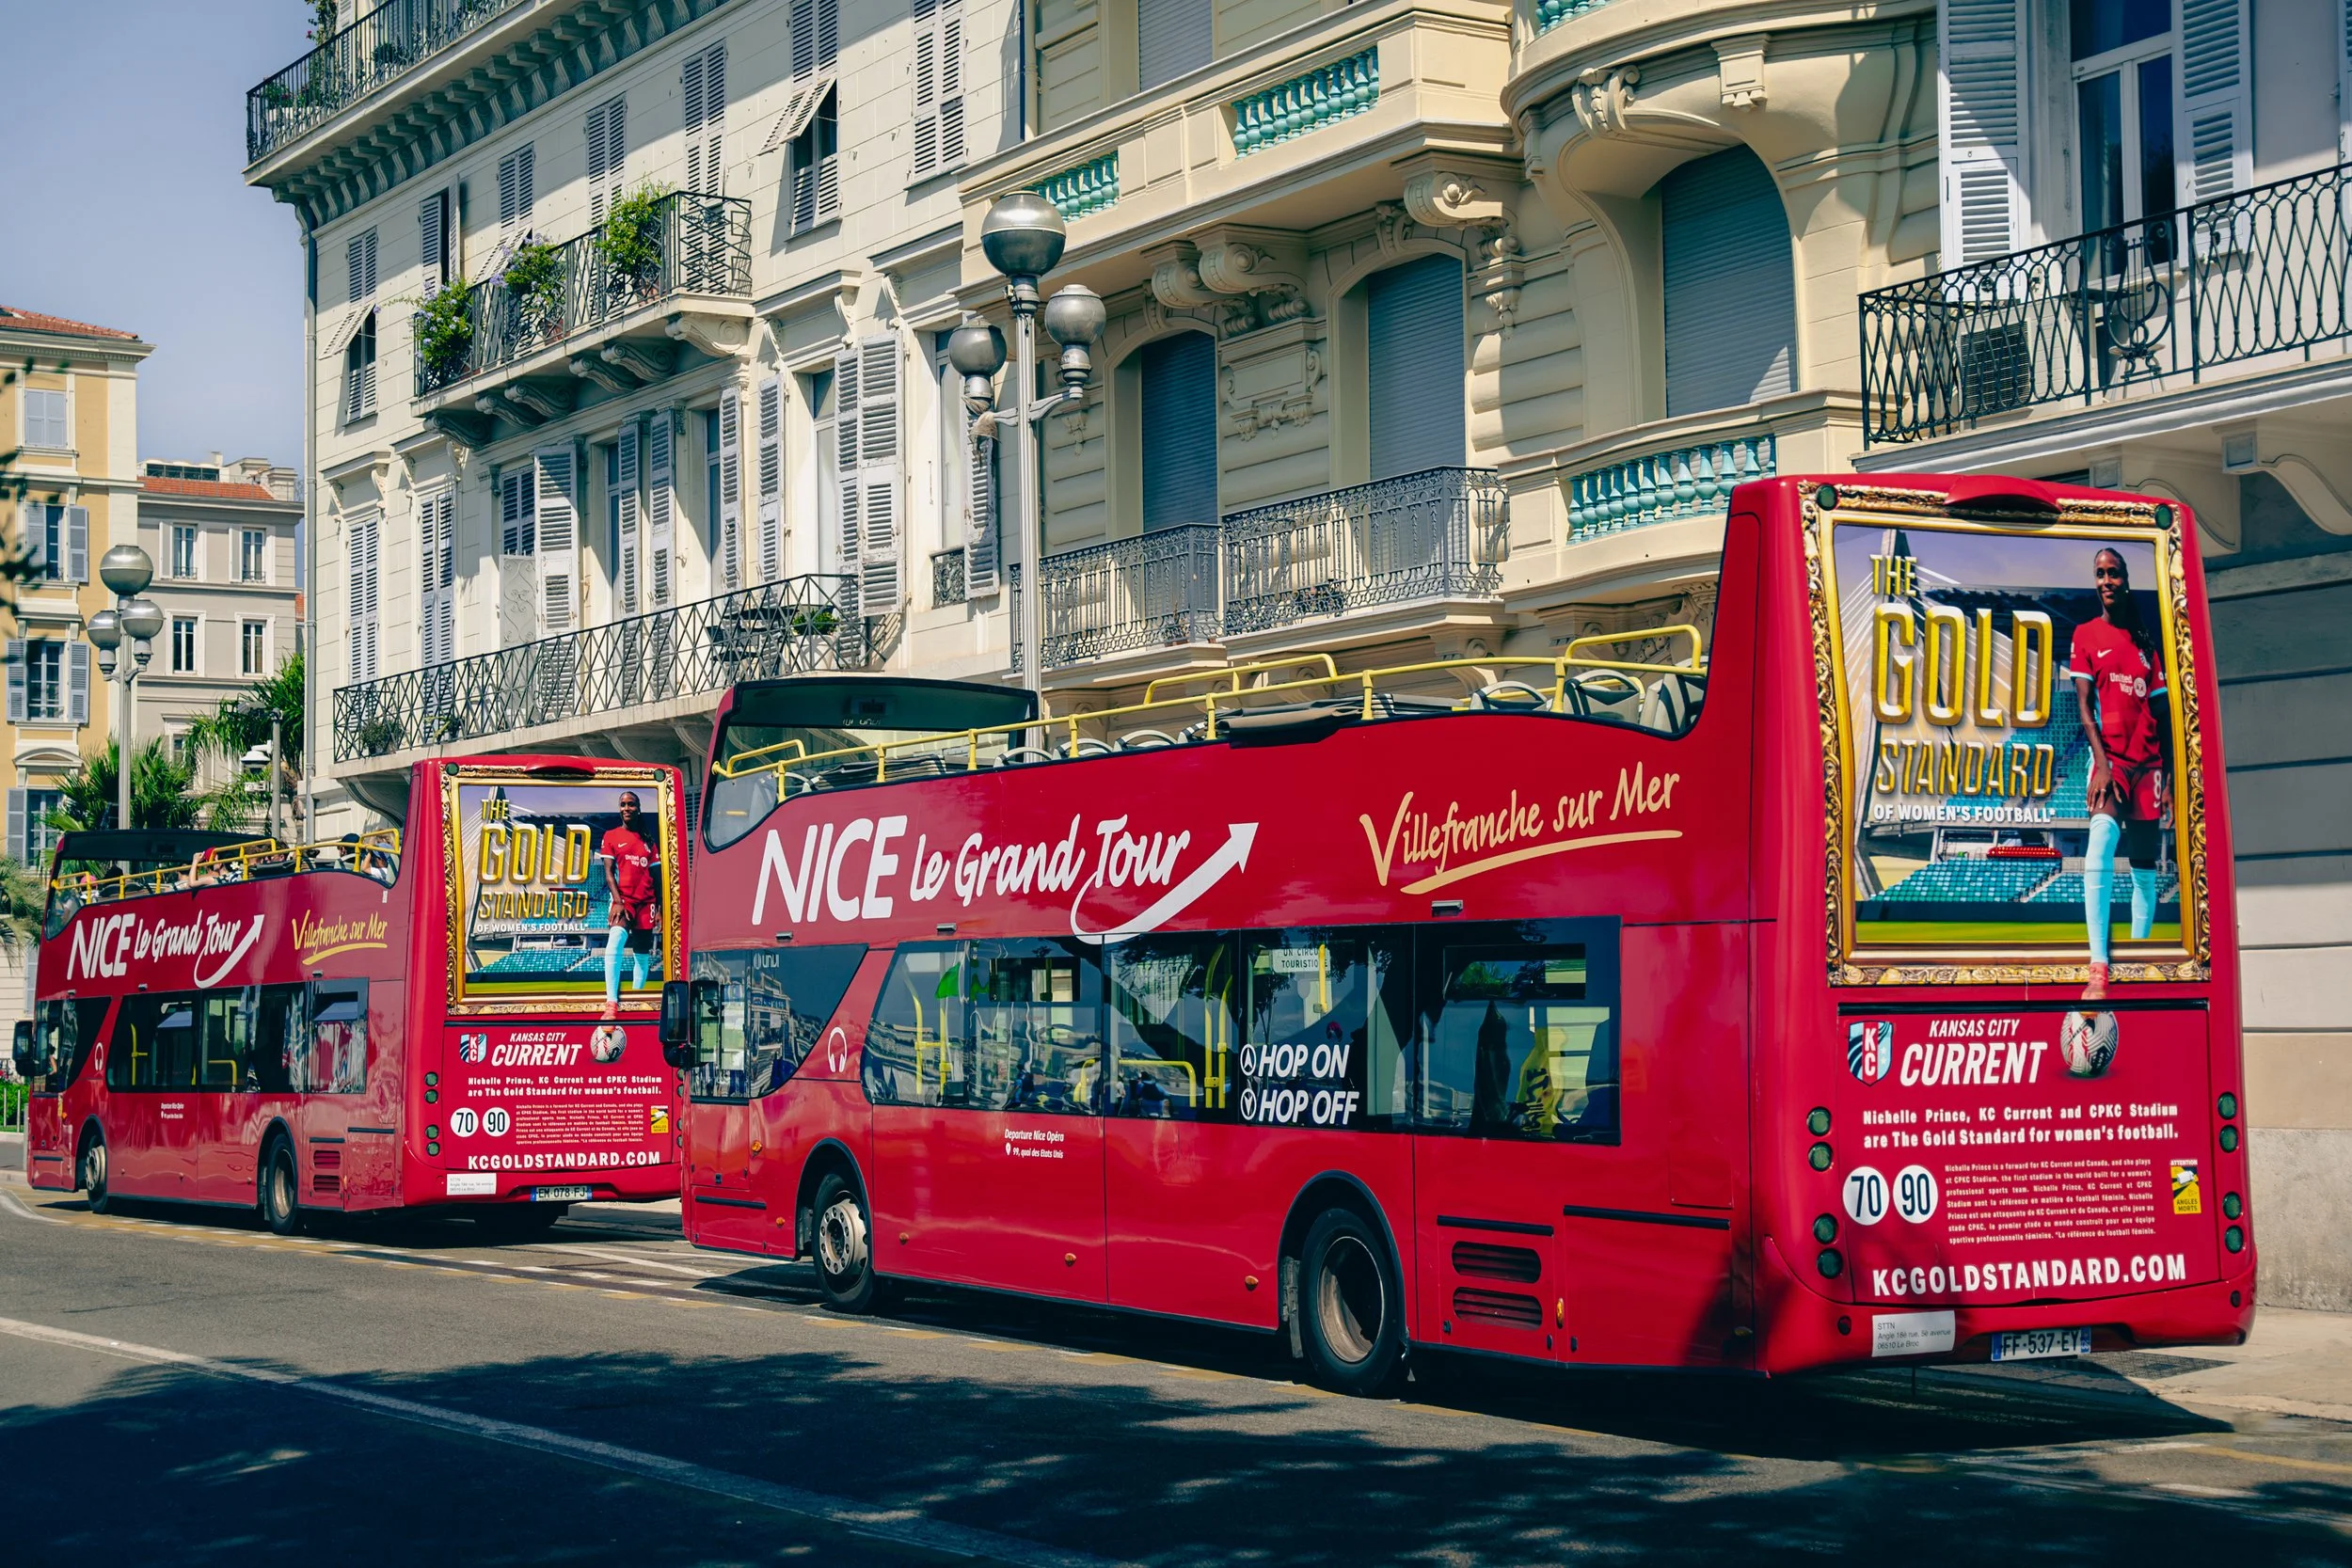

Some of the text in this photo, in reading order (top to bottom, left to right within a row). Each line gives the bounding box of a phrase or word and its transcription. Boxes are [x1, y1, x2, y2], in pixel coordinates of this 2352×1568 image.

[1869, 554, 1917, 597] THE
[1871, 603, 2053, 728] GOLD
[2109, 673, 2133, 684] United
[1874, 737, 2055, 798] STANDARD
[481, 799, 510, 820] THE
[1873, 804, 1894, 820] OF
[1898, 805, 1970, 821] WOMEN'S
[1359, 761, 1680, 886] Villefranche sur Mer
[478, 823, 592, 884] GOLD
[752, 815, 908, 926] NICE
[954, 813, 1085, 908] Grand
[1095, 814, 1191, 890] Tour
[478, 891, 588, 919] STANDARD
[292, 909, 388, 950] Villefranche sur Mer
[476, 924, 489, 933] OF
[491, 923, 536, 933] WOMEN'S
[67, 912, 135, 980] NICE
[153, 909, 203, 963] Grand
[204, 912, 241, 956] Tour
[510, 1032, 566, 1042] KANSAS CITY
[1865, 1028, 1876, 1052] K
[1929, 1019, 2020, 1037] KANSAS CITY
[491, 1044, 582, 1067] CURRENT
[1258, 1044, 1350, 1079] HOP ON
[1864, 1053, 1876, 1077] C
[1900, 1041, 2048, 1086] CURRENT
[469, 1077, 501, 1085] Nichelle
[485, 1087, 501, 1097] The
[503, 1087, 524, 1096] Gold
[526, 1086, 566, 1096] Standard
[568, 1086, 582, 1095] for
[584, 1086, 621, 1095] women's
[623, 1085, 661, 1095] football.
[1258, 1089, 1359, 1126] HOP OFF
[1863, 1103, 2178, 1125] Nichelle Prince, KC Current and CPKC Stadium
[456, 1112, 505, 1132] 70 90
[1005, 1128, 1033, 1141] Departure
[1033, 1130, 1046, 1141] Nice
[1864, 1123, 2178, 1148] are The Gold Standard for women's football.
[469, 1151, 660, 1169] KCGOLDSTANDARD.COM
[1851, 1174, 1931, 1217] 70 90
[1946, 1188, 1984, 1196] professional
[1873, 1254, 2185, 1296] KCGOLDSTANDARD.COM
